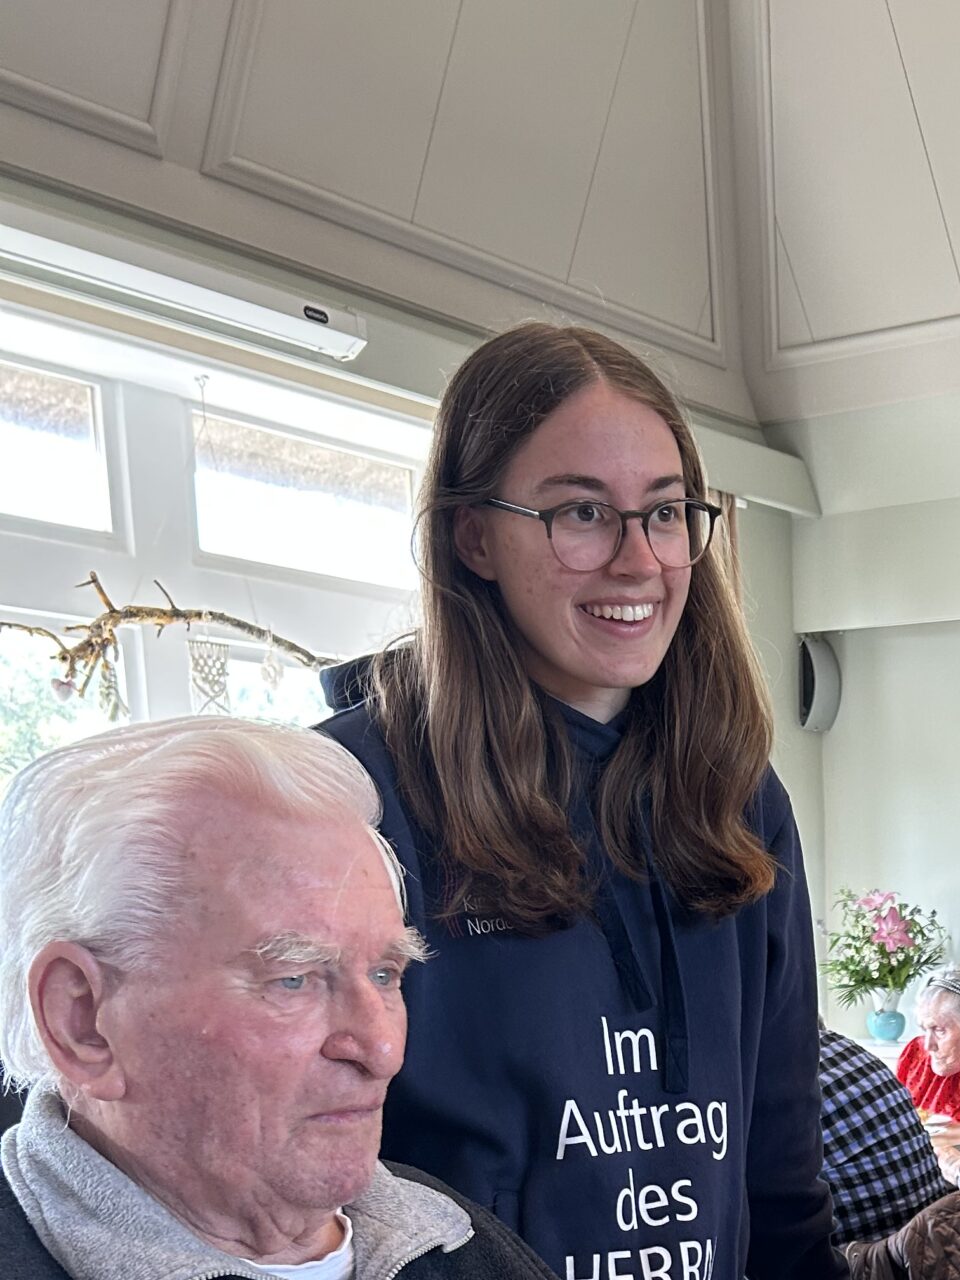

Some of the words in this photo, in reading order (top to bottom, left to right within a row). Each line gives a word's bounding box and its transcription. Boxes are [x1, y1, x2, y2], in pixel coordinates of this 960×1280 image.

[601, 1016, 659, 1075] Im
[556, 1089, 728, 1161] Auftrag
[616, 1167, 698, 1232] des
